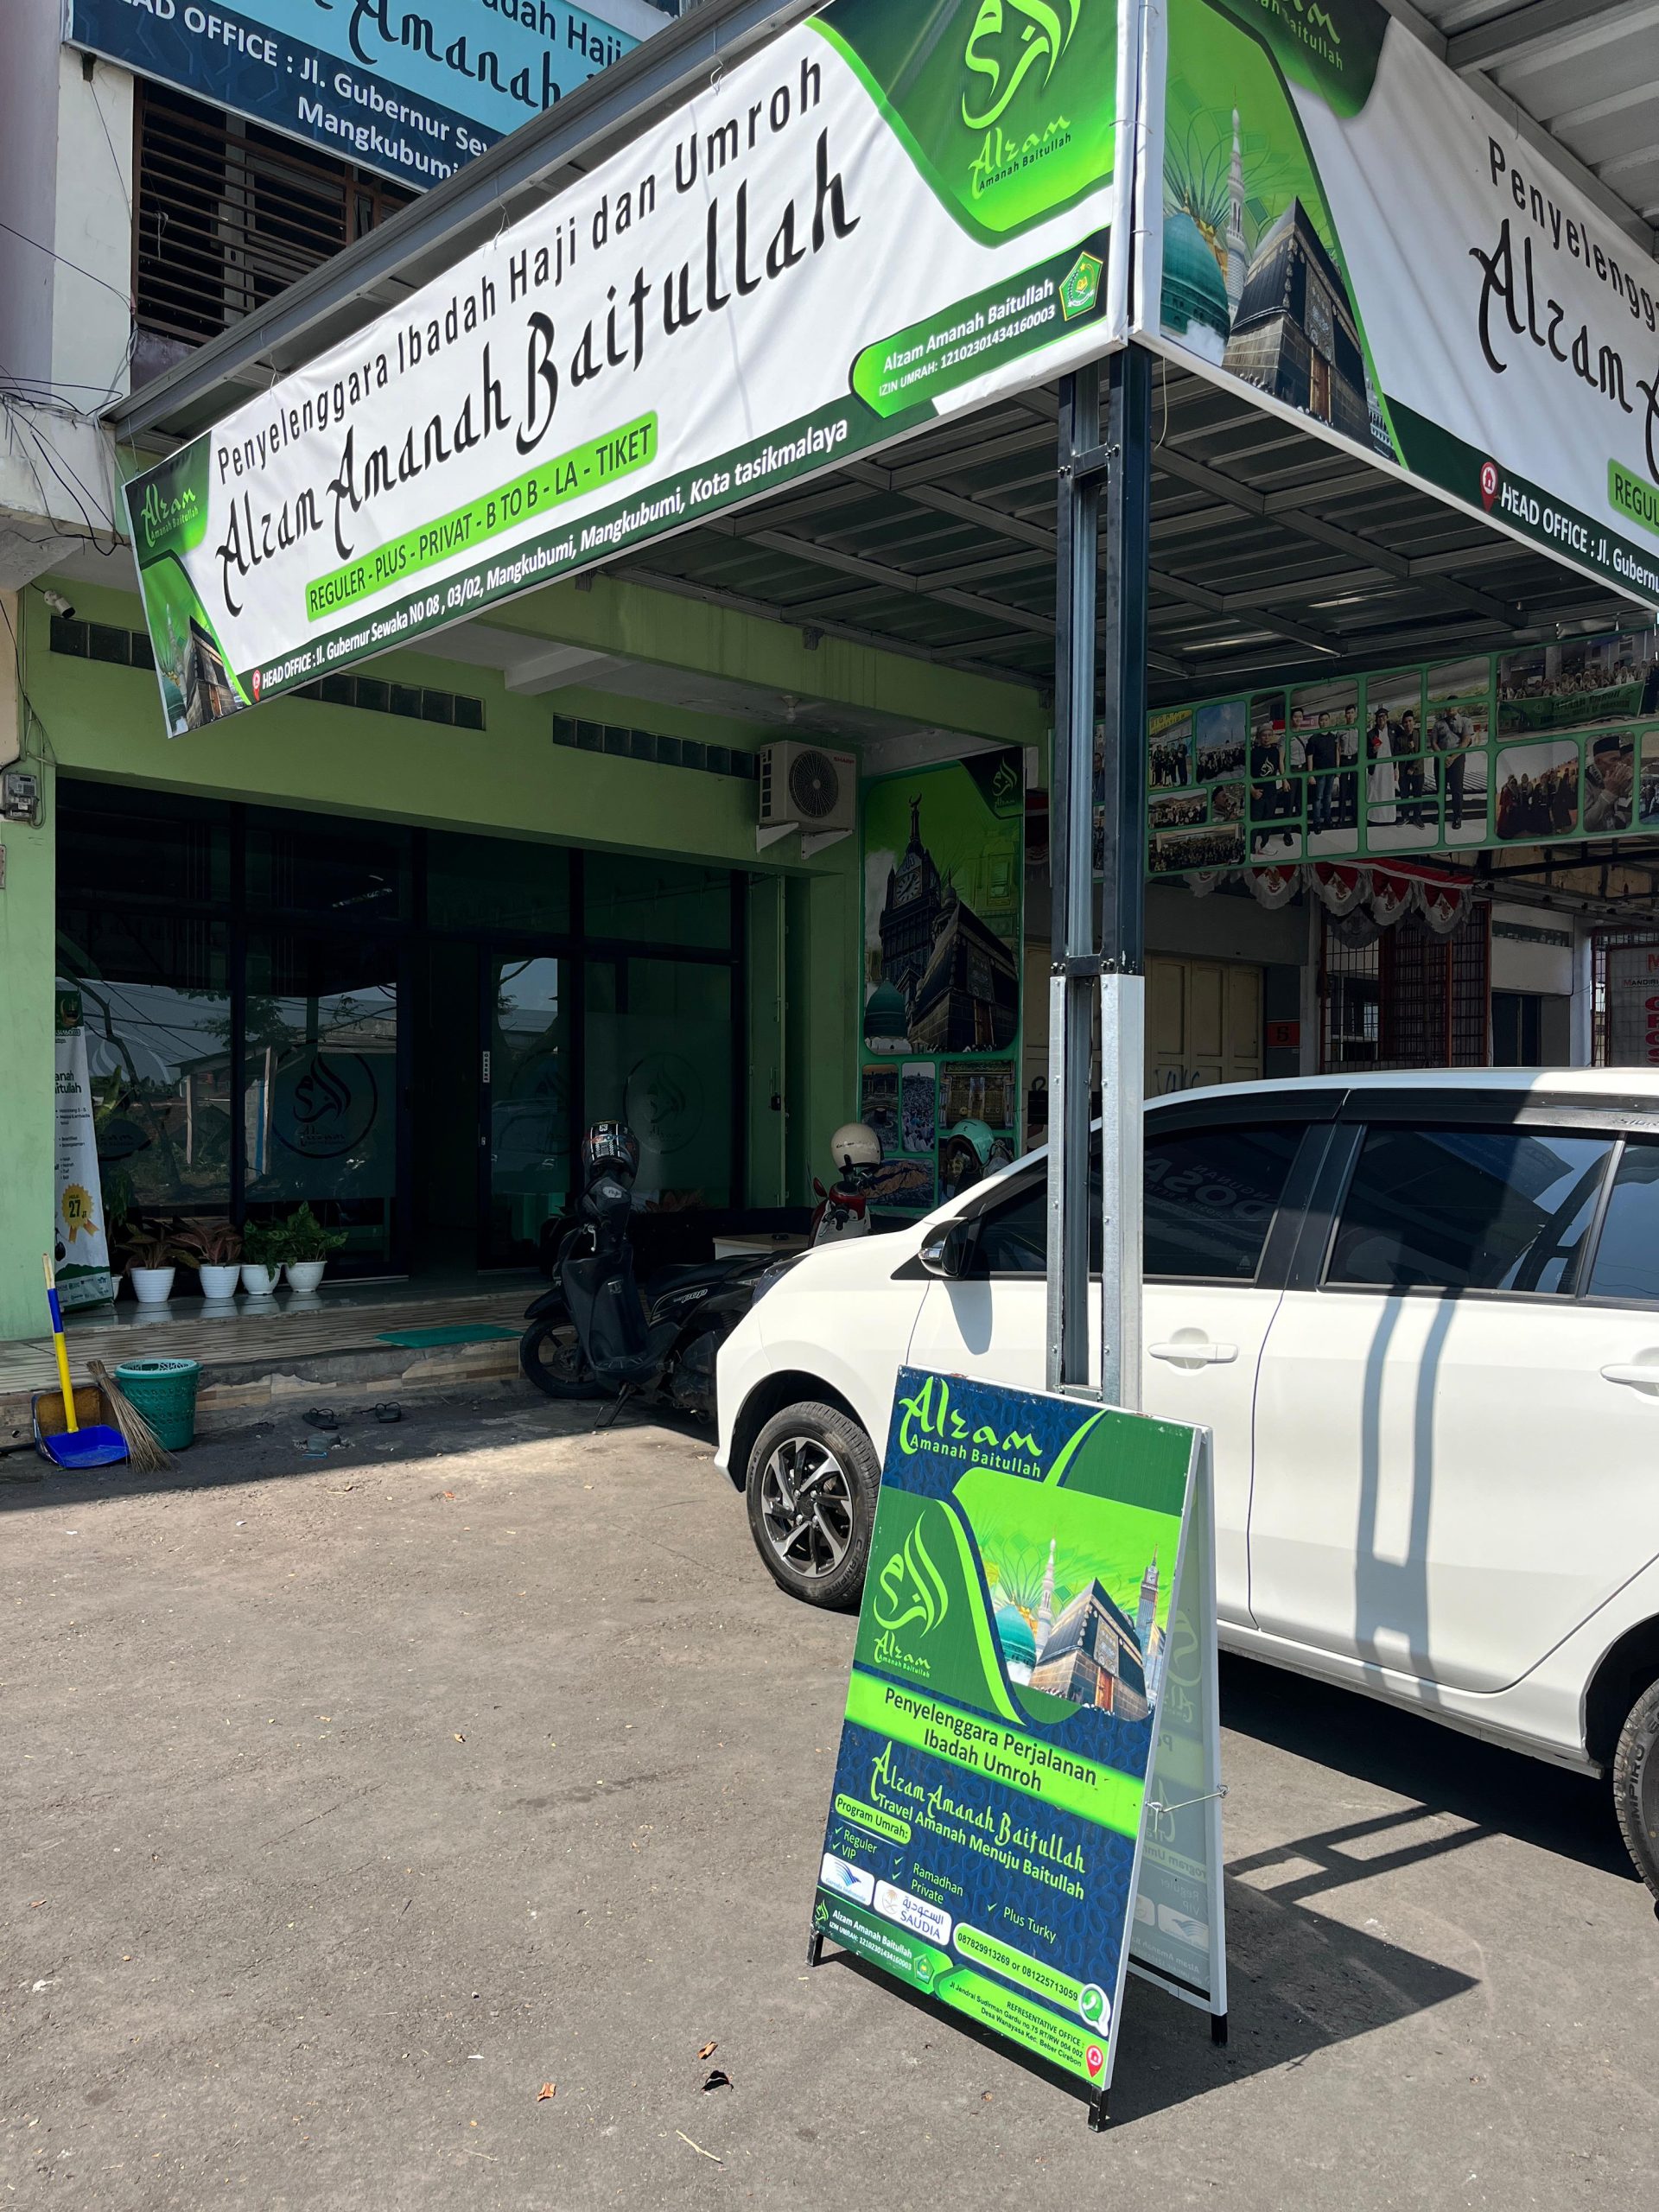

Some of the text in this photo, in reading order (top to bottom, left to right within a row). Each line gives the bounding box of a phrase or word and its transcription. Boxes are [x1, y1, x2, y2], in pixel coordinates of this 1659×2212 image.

[184, 7, 278, 67] OFFICE
[300, 58, 326, 87] Jl.
[334, 73, 450, 141] Gubernur
[968, 115, 1071, 200] Alzam
[979, 132, 1071, 191] Amanah Baitullah
[1488, 136, 1659, 333] Penyelengg
[218, 56, 822, 485] Penyelenggara Ibadah Haji dan Umroh
[883, 279, 1053, 373] Alzam Amanah Baitullah
[1469, 218, 1633, 413] Alzam
[215, 126, 861, 617] Alzam Amanah Baitullah
[879, 380, 899, 397] IZIN
[900, 361, 938, 388] UMRAH:
[141, 483, 196, 548] Alzam
[150, 520, 173, 540] Amanah
[309, 567, 366, 613] REGULER
[375, 544, 406, 582] PLUS
[419, 512, 474, 561] PRIVAT
[486, 501, 496, 529] B
[499, 488, 522, 520] TO
[527, 480, 538, 509] B
[555, 461, 578, 495] LA
[596, 423, 652, 476] TIKET
[1501, 482, 1540, 526] HEAD
[1542, 508, 1588, 555] OFFICE
[1597, 538, 1610, 566] Jl.
[262, 667, 283, 690] HEAD
[284, 652, 312, 678] OFFICE
[327, 629, 371, 661] Gubernur
[371, 611, 409, 642] Sewaka
[486, 535, 577, 591] Mangkubumi,
[580, 486, 685, 552] Mangkubumi,
[690, 470, 731, 505] Kota
[734, 419, 849, 485] tasikmalaya
[55, 1071, 74, 1082] anah
[68, 1199, 81, 1218] 27
[899, 1376, 1042, 1457] Alzam
[910, 1433, 1040, 1478] Amanah Baitullah
[874, 1630, 931, 1669] Alzam
[879, 1654, 931, 1679] Amanah Baitullah
[885, 1687, 1096, 1786] Penyelenggara Perjalanan
[924, 1728, 1042, 1792] Ibadah Umroh
[836, 1797, 908, 1840] Program Umrah:
[870, 1740, 1086, 1874] Alzam Amanah Baitullah
[842, 1844, 856, 1859] VIP
[843, 1829, 878, 1854] Reguler
[877, 1793, 1085, 1900] Travel Amanah Menuju Baitullah
[911, 1878, 944, 1904] Private
[912, 1862, 963, 1897] Ramadhan
[832, 1910, 853, 1927] Alzam
[853, 1921, 881, 1942] Amanah
[882, 1935, 912, 1959] Baitullah
[899, 1911, 941, 1941] SAUDIA
[1003, 1906, 1057, 1944] Plus Turky
[957, 1932, 1078, 2001] 087829913269 or 081225713059
[955, 1985, 976, 1999] Jendral
[976, 1996, 1003, 2014] Sudirman
[1003, 2011, 1021, 2024] Gardu
[981, 2007, 995, 2019] Desa
[1039, 2039, 1057, 2053] Beber
[1058, 2048, 1082, 2068] Cirebon
[1058, 2029, 1081, 2046] OFFICE
